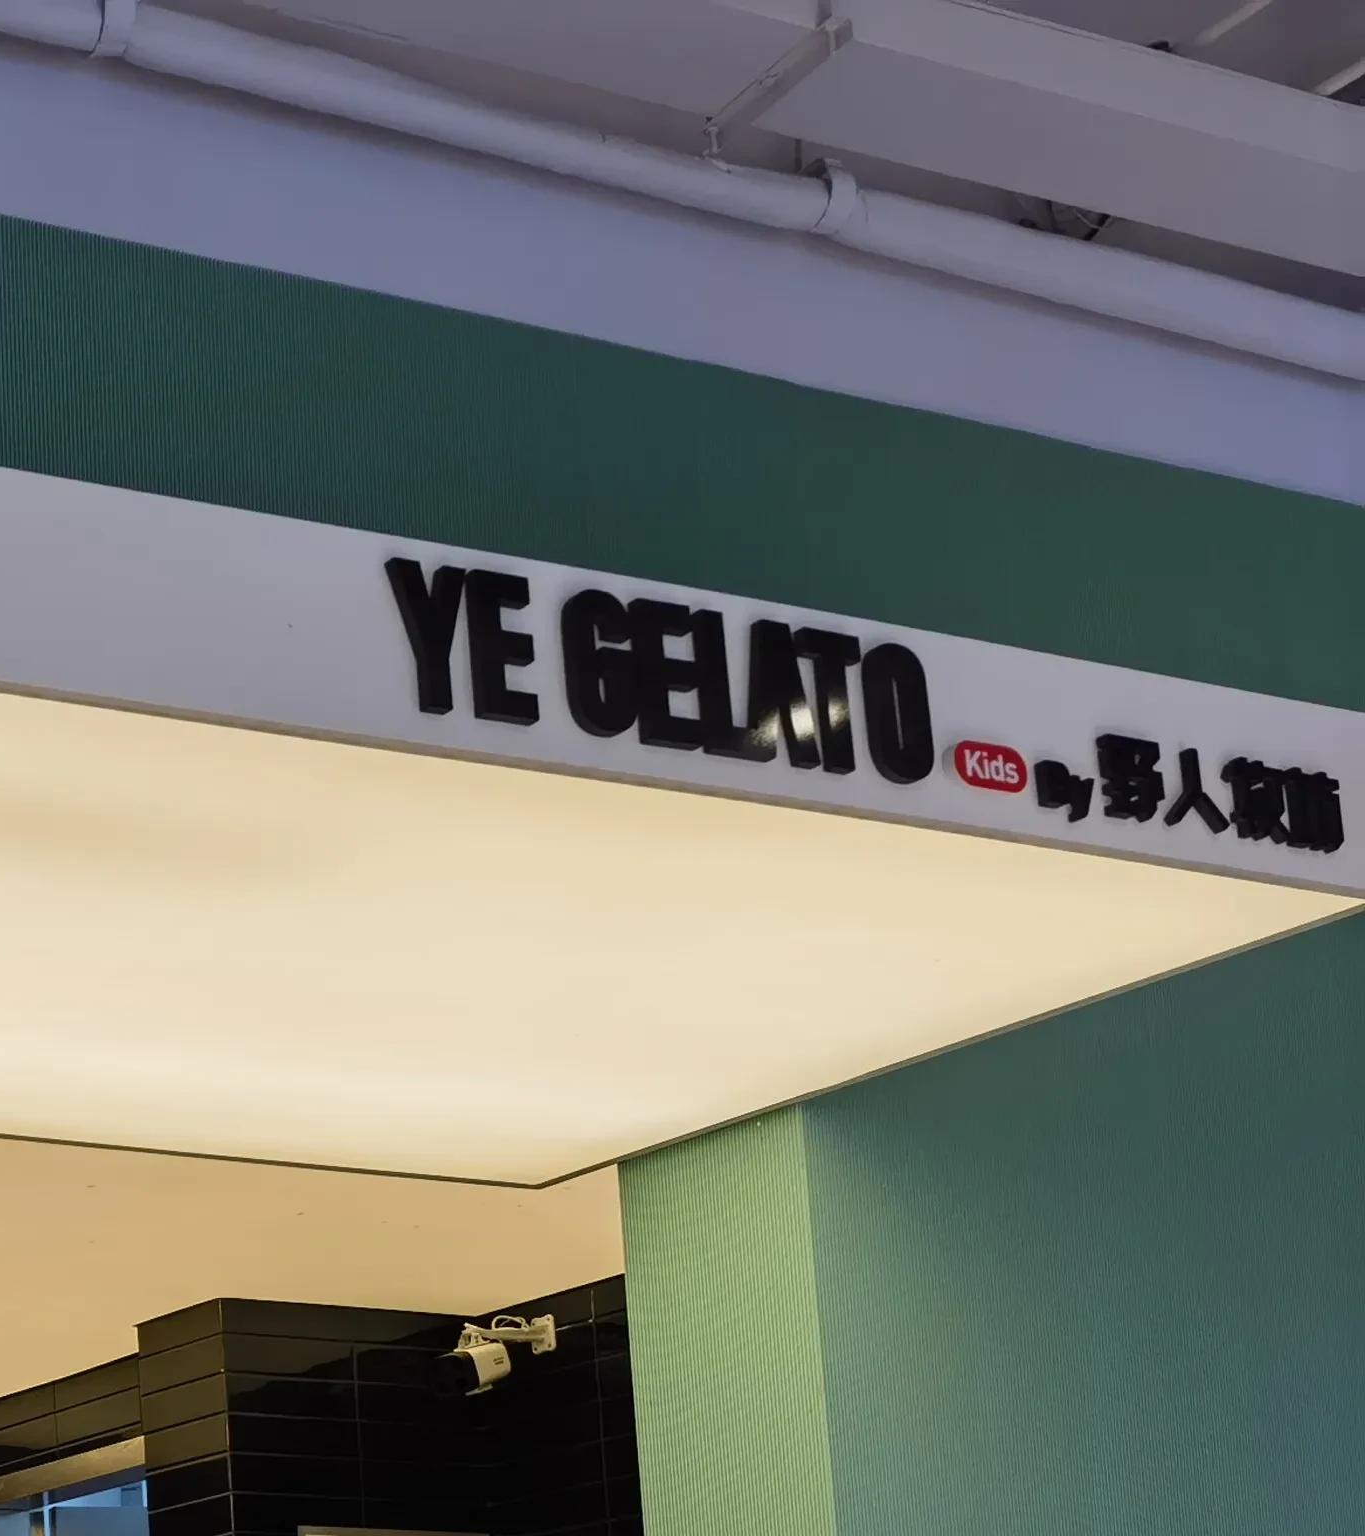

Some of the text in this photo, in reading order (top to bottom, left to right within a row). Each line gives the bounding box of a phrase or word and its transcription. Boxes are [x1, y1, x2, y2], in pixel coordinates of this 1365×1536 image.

[384, 557, 934, 784] YE GELATO
[963, 749, 1019, 786] Kids
